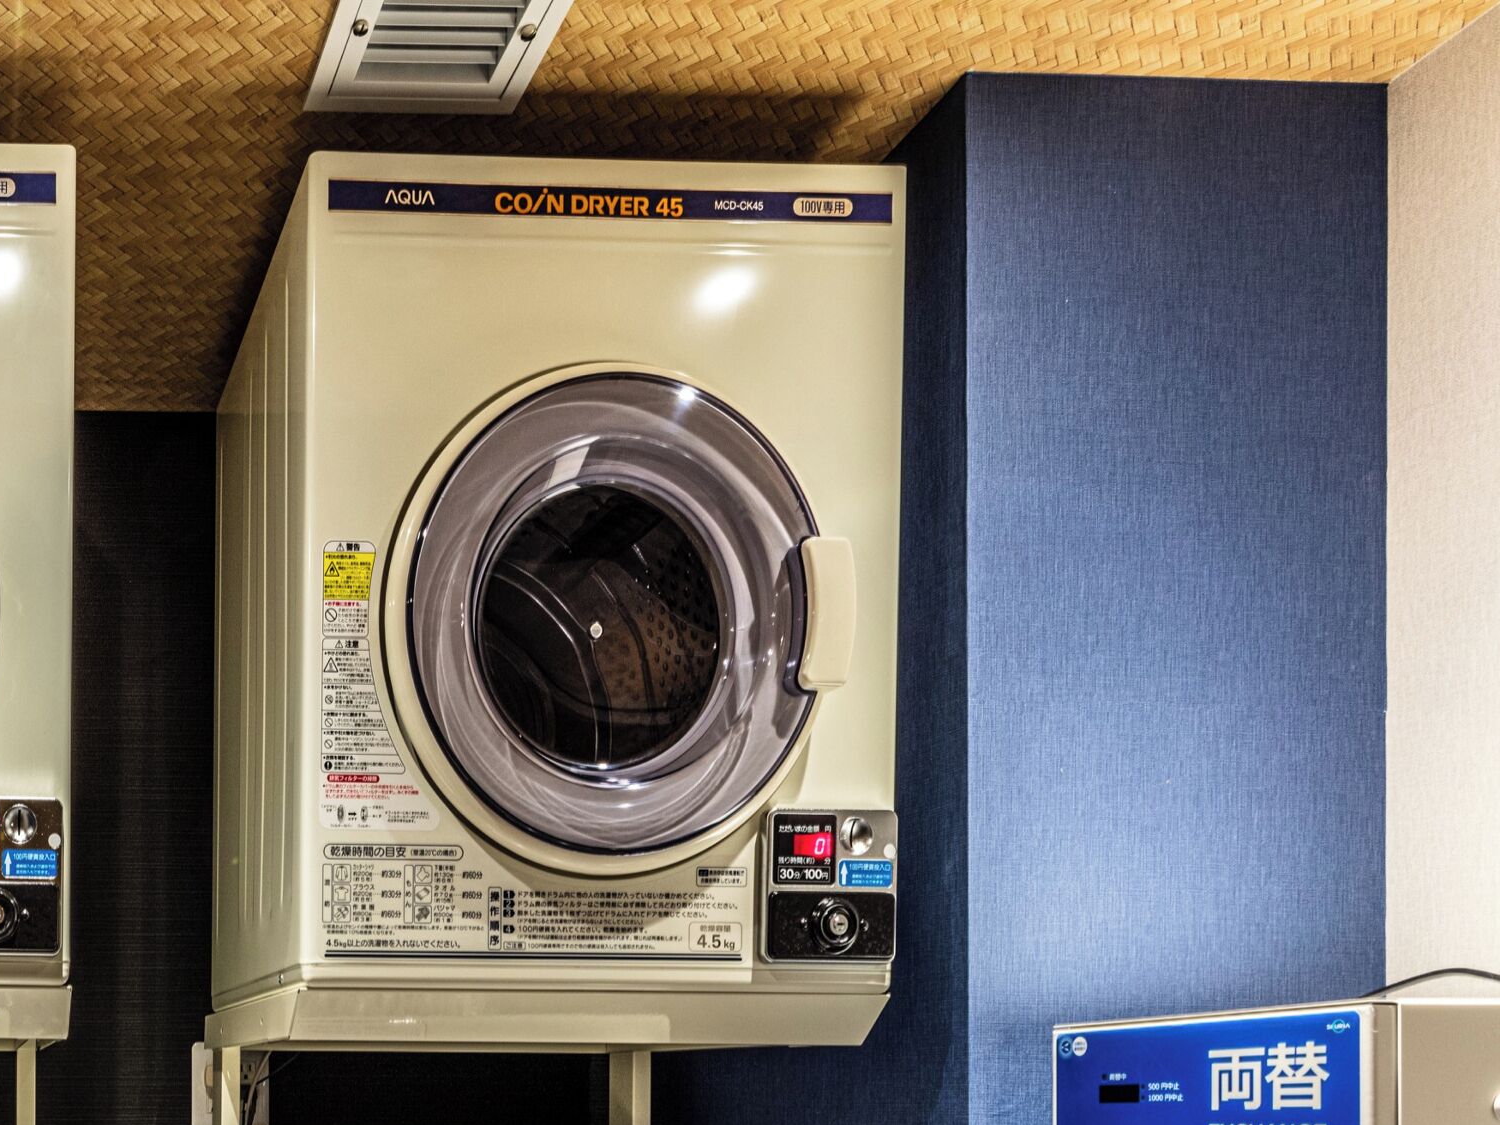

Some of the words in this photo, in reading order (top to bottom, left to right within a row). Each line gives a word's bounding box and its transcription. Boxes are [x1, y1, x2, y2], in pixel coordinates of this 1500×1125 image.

[385, 189, 435, 206] AQUA
[571, 193, 649, 217] DRYER
[656, 197, 683, 218] 45
[714, 200, 764, 212] MCD-CK45
[800, 199, 845, 215] 100V専用
[330, 847, 406, 857] 乾燥時間の目安
[814, 839, 825, 854] 0
[780, 869, 828, 879] 30分/100円
[381, 910, 401, 918] 約60分
[700, 925, 731, 933] 乾燥容量
[326, 940, 460, 948] 4.5kg以上の洗濯物を入れないでください。
[697, 934, 722, 949] 4.5
[724, 940, 736, 950] kg
[1208, 1041, 1330, 1111] 両替
